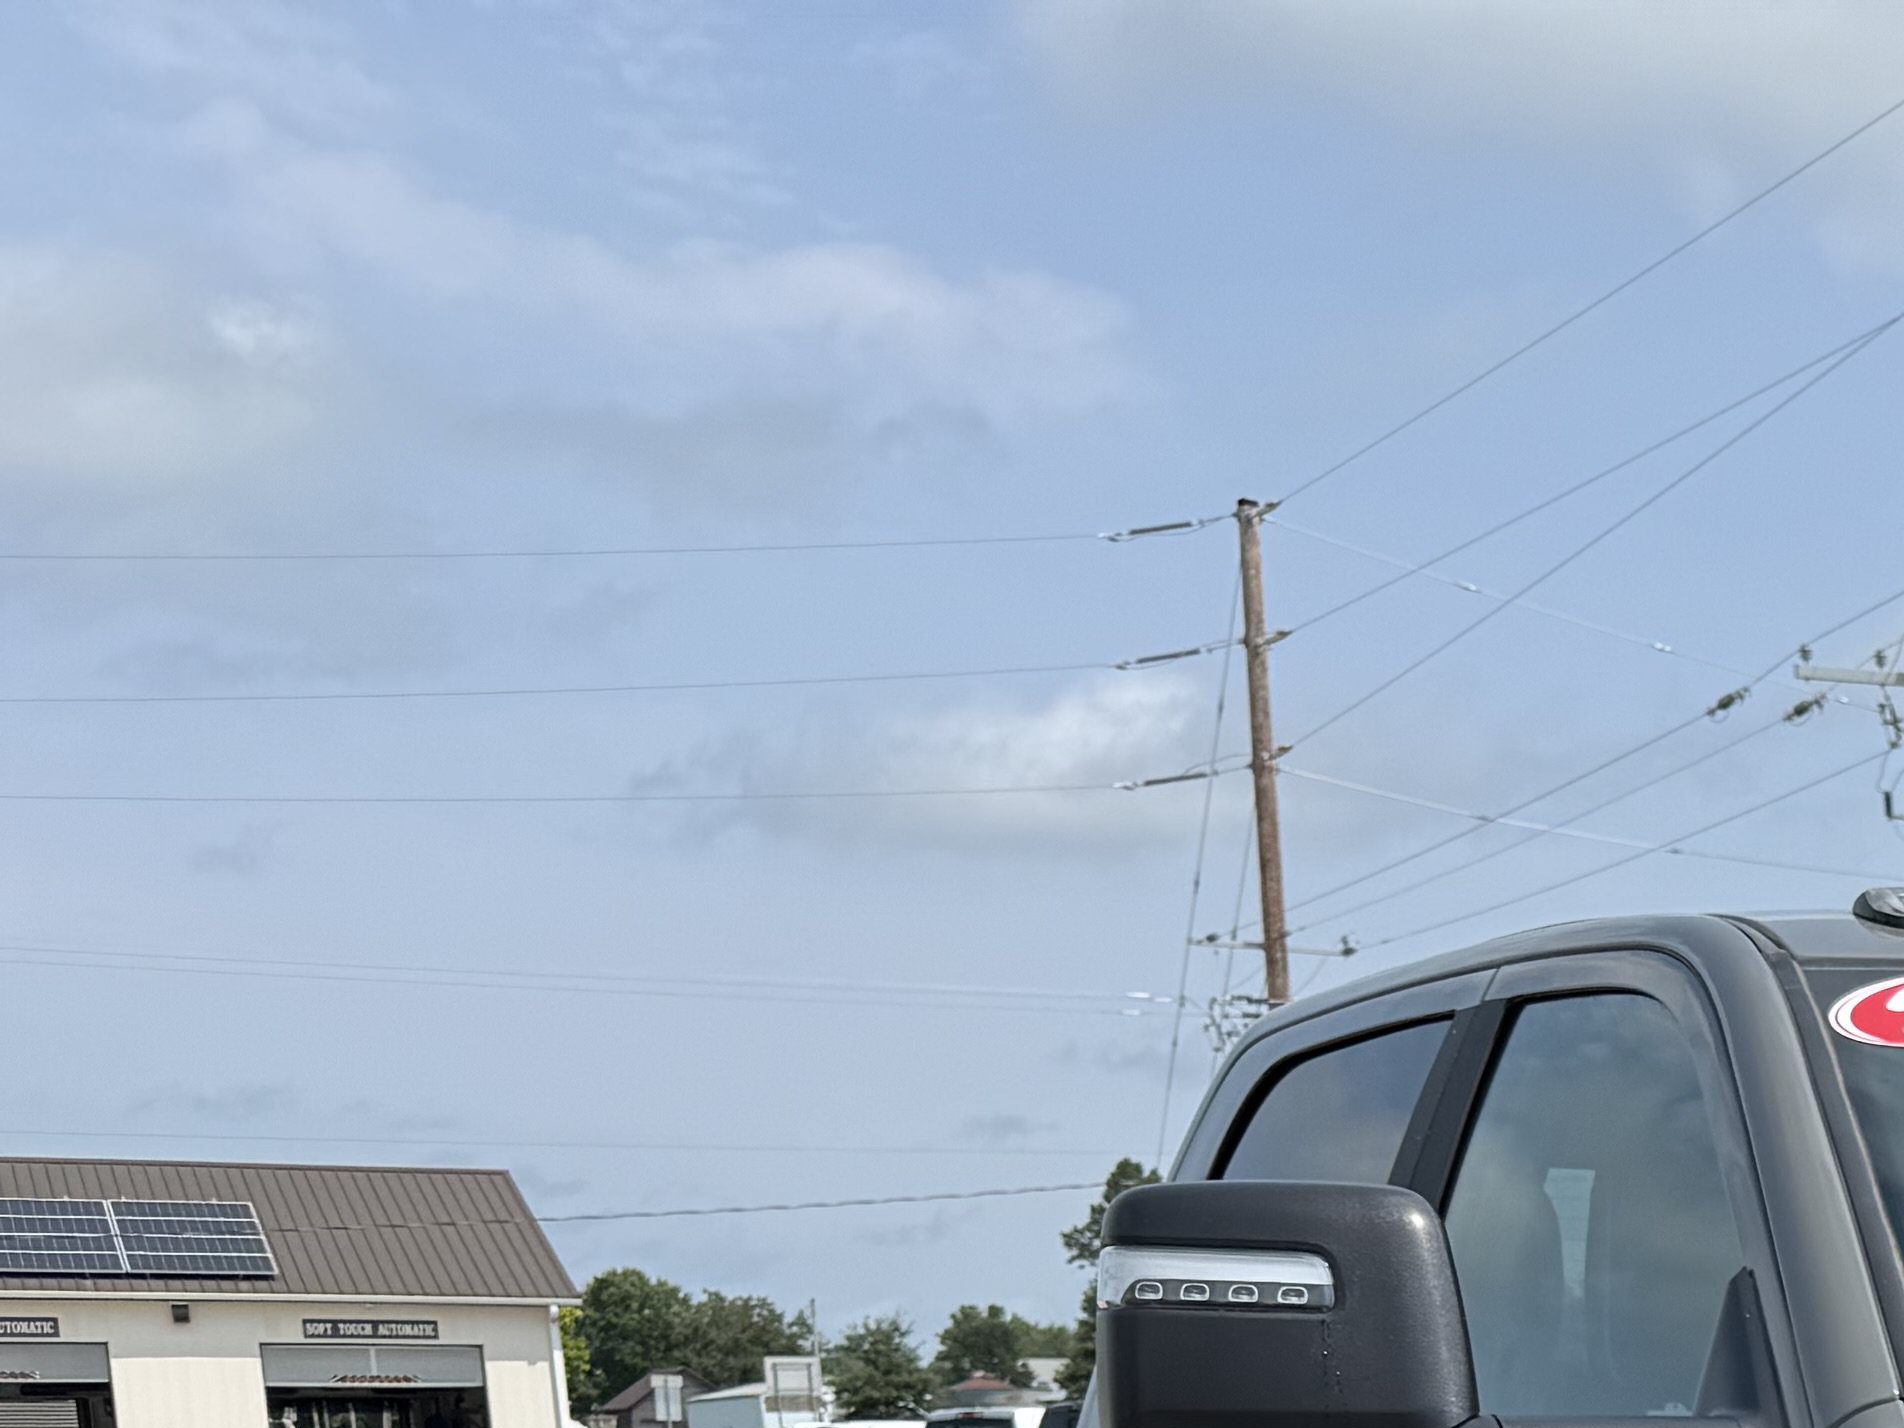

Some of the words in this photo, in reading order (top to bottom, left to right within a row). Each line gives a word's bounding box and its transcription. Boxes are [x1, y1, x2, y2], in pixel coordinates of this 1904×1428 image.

[0, 1321, 55, 1334] UTOMATIC
[305, 1322, 333, 1336] SOFT
[338, 1323, 373, 1336] TOUCH
[377, 1324, 436, 1337] AUTOMATIC
